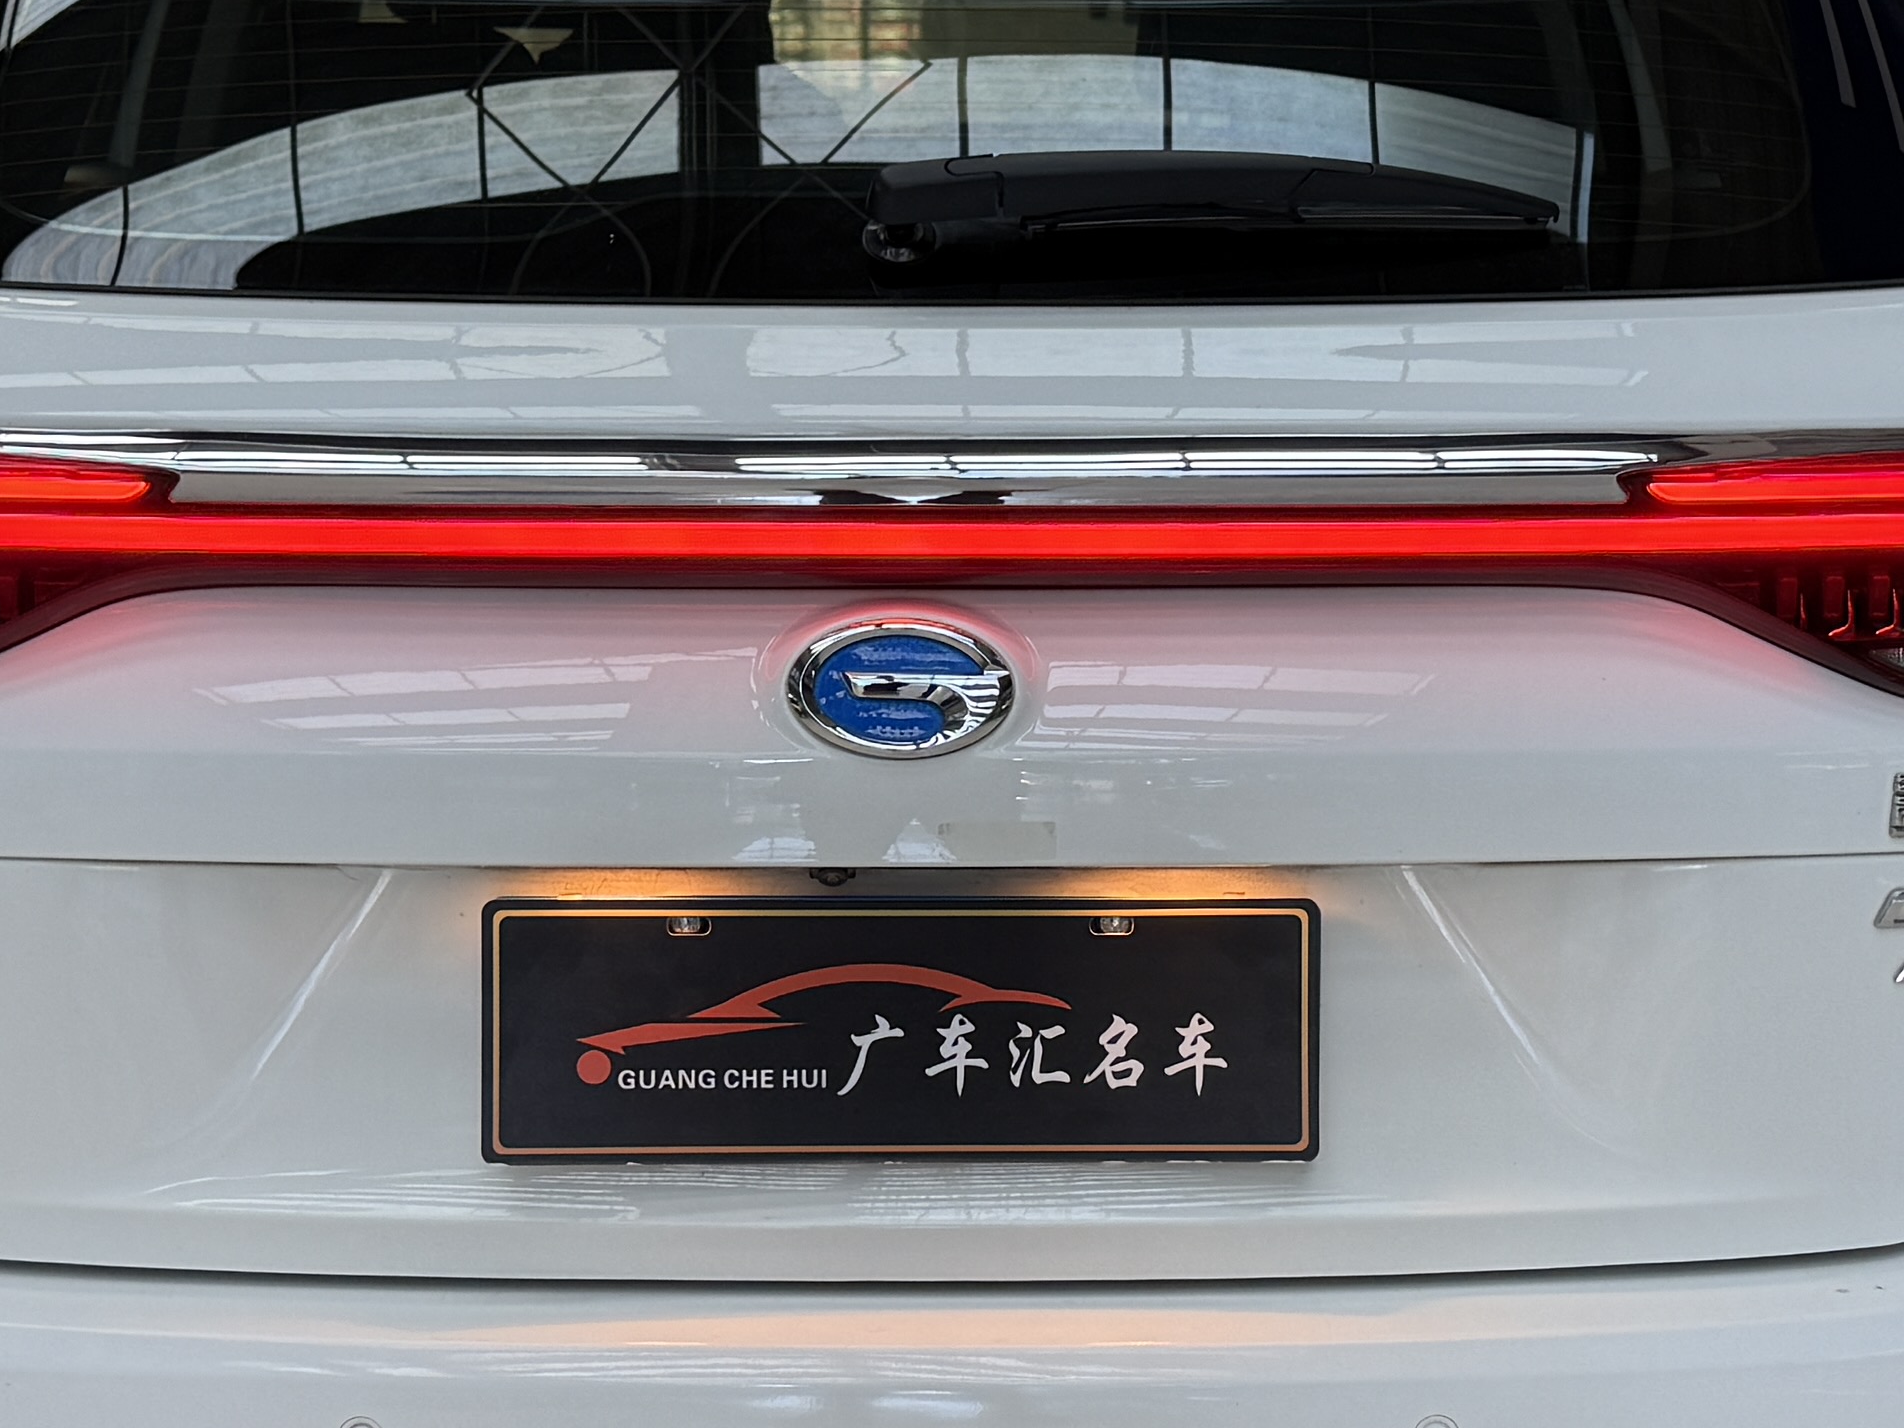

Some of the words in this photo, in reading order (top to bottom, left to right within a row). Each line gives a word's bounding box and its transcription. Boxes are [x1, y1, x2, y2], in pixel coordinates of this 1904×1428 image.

[618, 1070, 716, 1090] GUANG
[723, 1069, 775, 1089] CHE
[782, 1069, 828, 1089] HUI
[837, 1013, 1229, 1098] 广车汇名车
